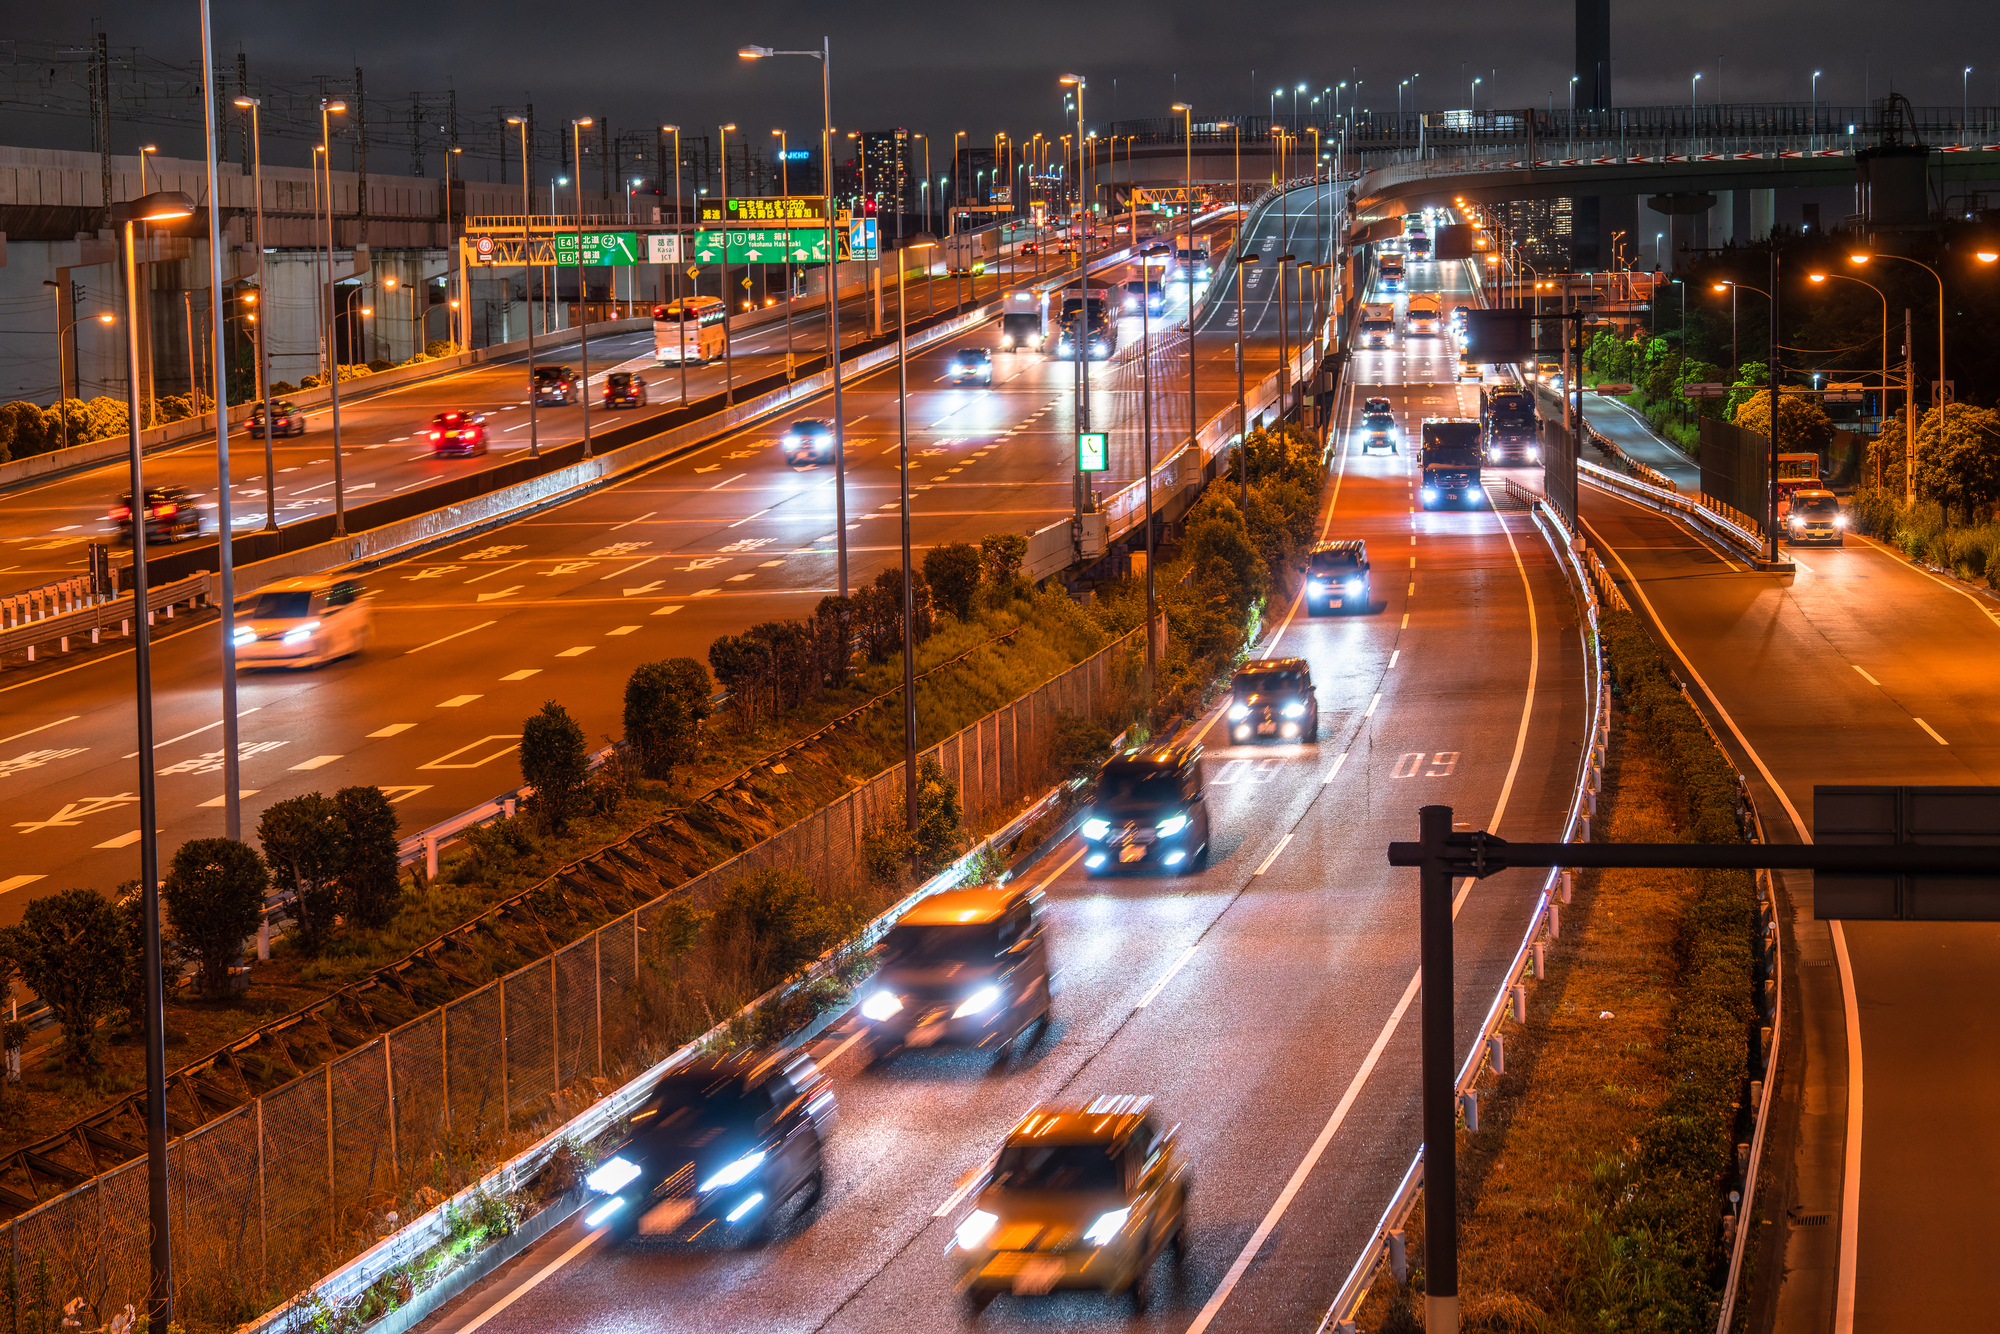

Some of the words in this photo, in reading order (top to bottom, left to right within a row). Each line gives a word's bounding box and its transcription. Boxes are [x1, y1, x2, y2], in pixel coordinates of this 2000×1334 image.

[736, 235, 742, 243] 9
[748, 232, 765, 241] 横浜
[560, 239, 571, 247] E4
[603, 237, 613, 245] C2
[657, 238, 674, 246] 葛西
